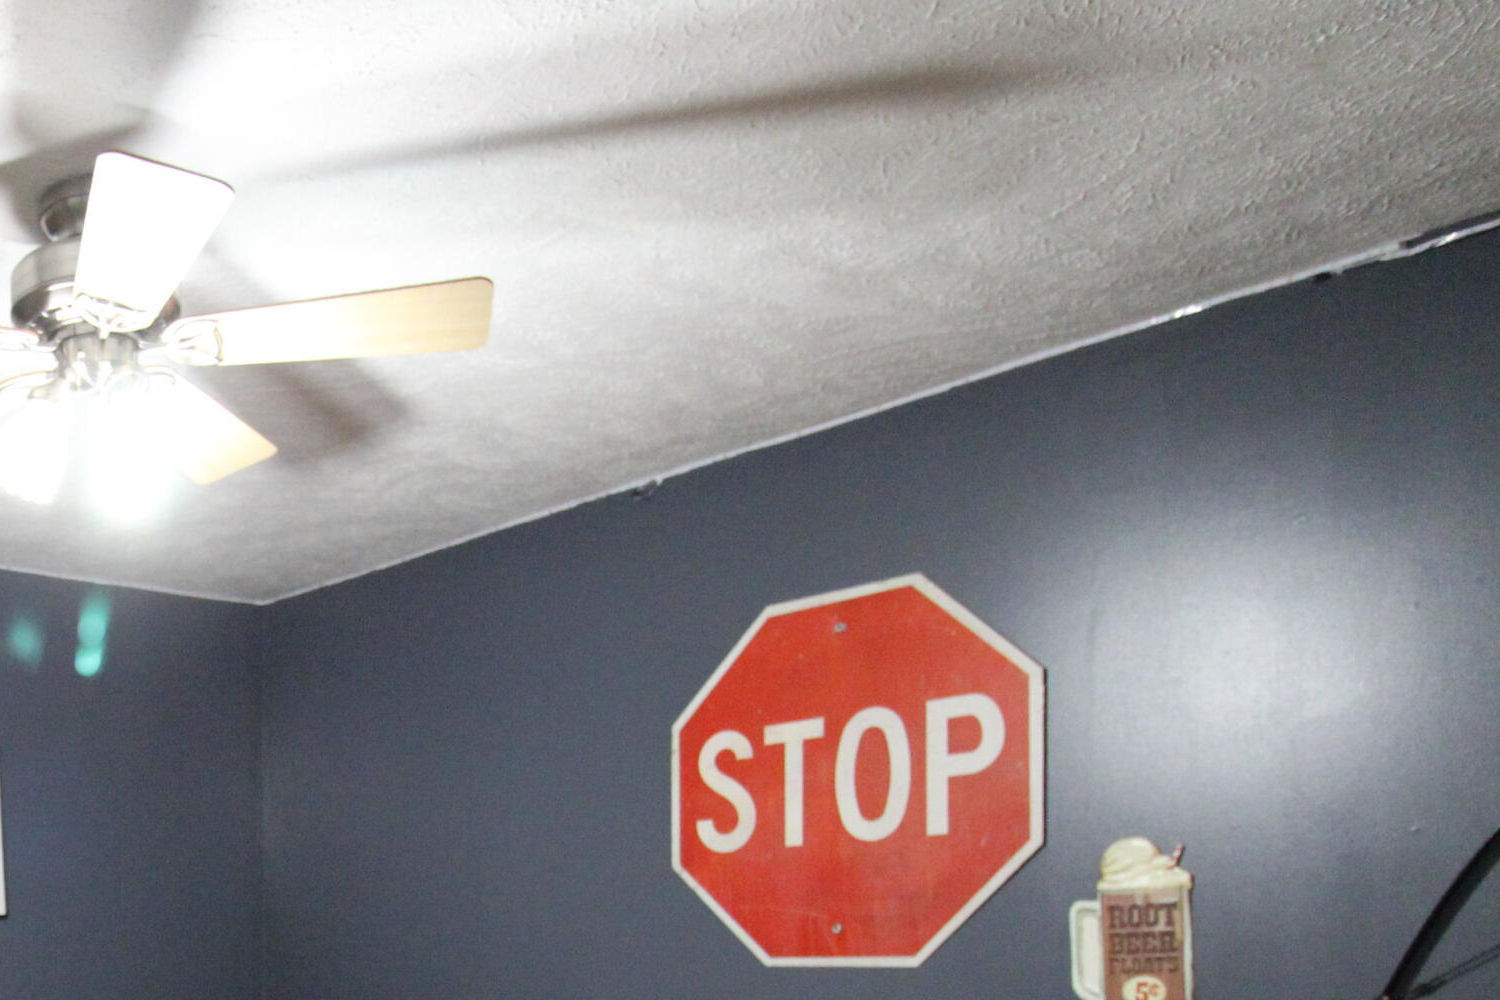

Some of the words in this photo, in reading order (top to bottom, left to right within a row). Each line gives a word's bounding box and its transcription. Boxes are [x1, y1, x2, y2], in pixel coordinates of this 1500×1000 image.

[696, 693, 1005, 854] STOP
[1108, 903, 1177, 929] ROOT
[1108, 931, 1178, 954] BEER
